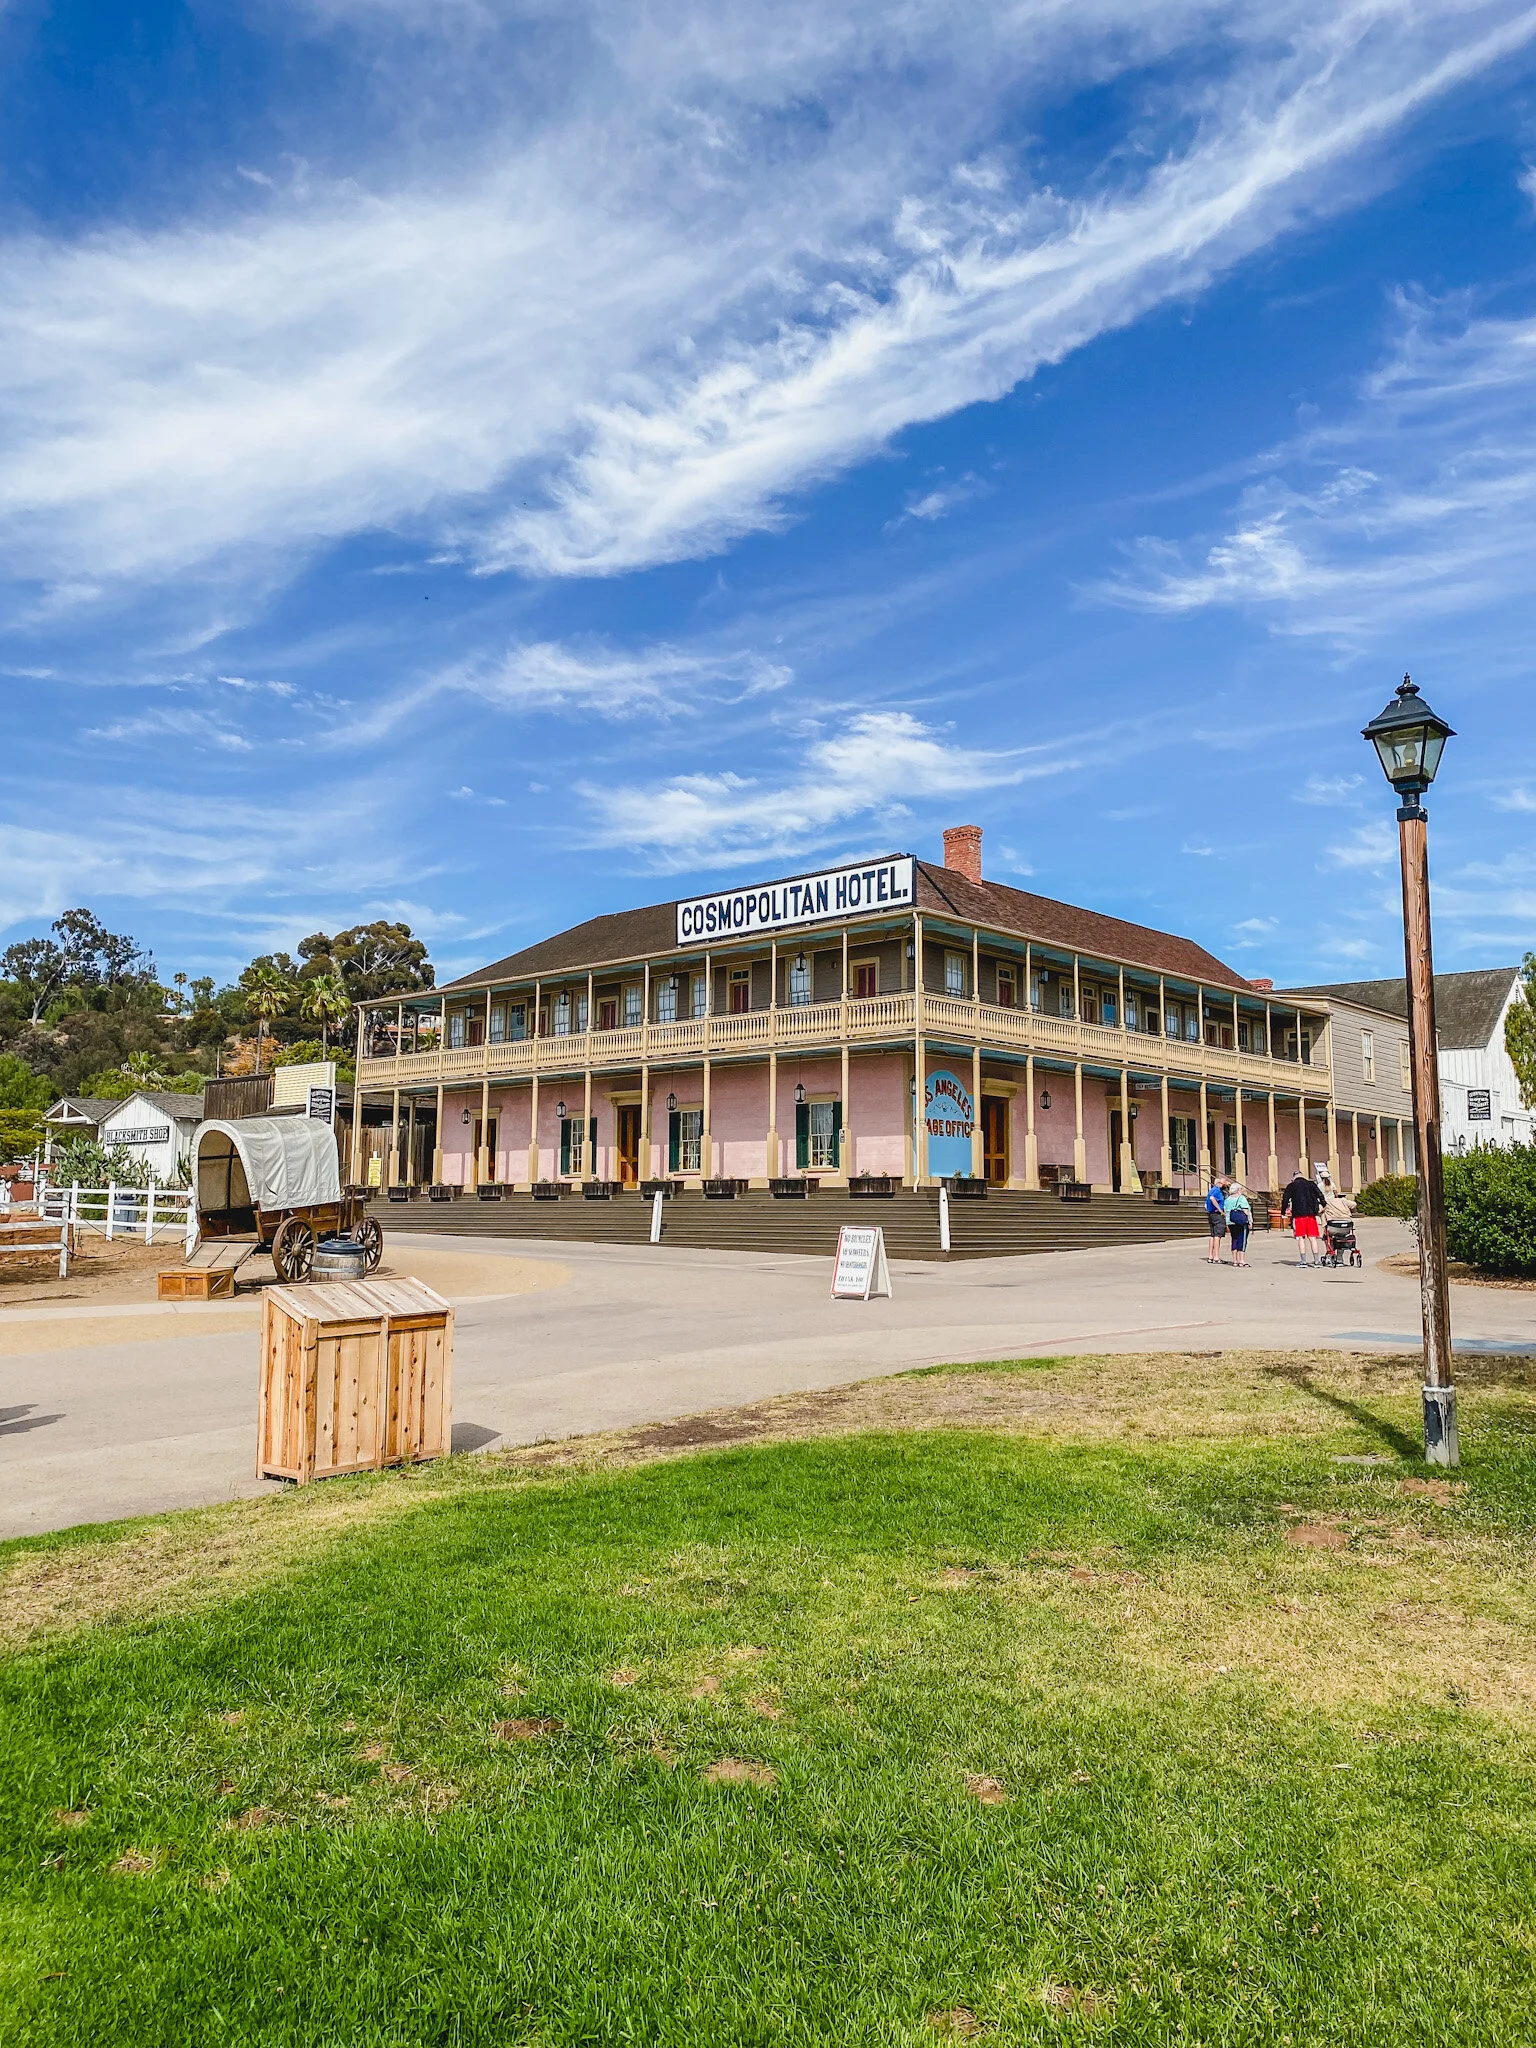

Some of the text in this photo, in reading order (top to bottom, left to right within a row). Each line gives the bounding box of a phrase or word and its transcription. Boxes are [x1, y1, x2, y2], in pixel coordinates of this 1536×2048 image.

[682, 866, 908, 936] COSMOPOLITAN HOTEL.
[935, 1079, 972, 1120] ANGELES
[107, 1130, 147, 1142] BLACKSMITH
[914, 1117, 944, 1136] AGE
